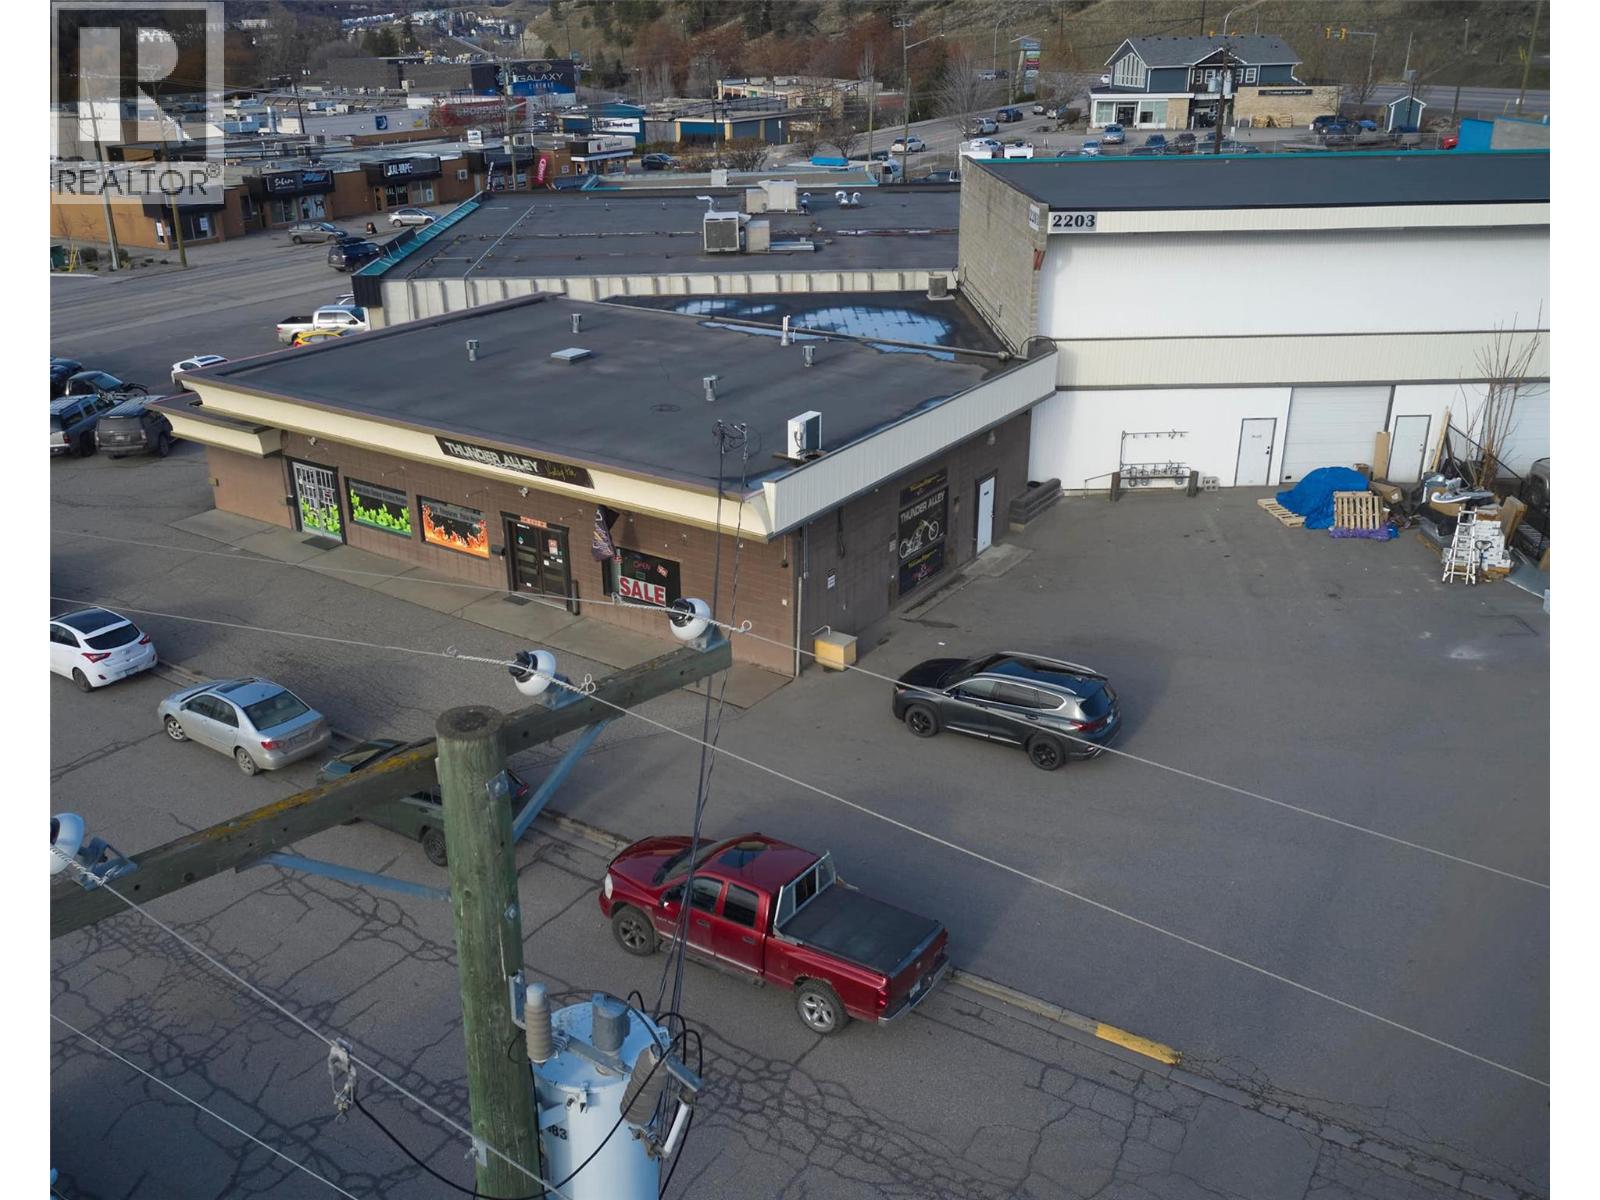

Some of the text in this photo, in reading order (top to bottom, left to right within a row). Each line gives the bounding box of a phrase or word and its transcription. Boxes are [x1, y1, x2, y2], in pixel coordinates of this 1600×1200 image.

[517, 73, 564, 83] GALAXY
[1052, 214, 1095, 228] 2203
[444, 442, 501, 464] THUNDER
[503, 455, 538, 473] ALLEY
[900, 491, 946, 522] THUNDER ALLEY
[619, 576, 666, 605] SALE
